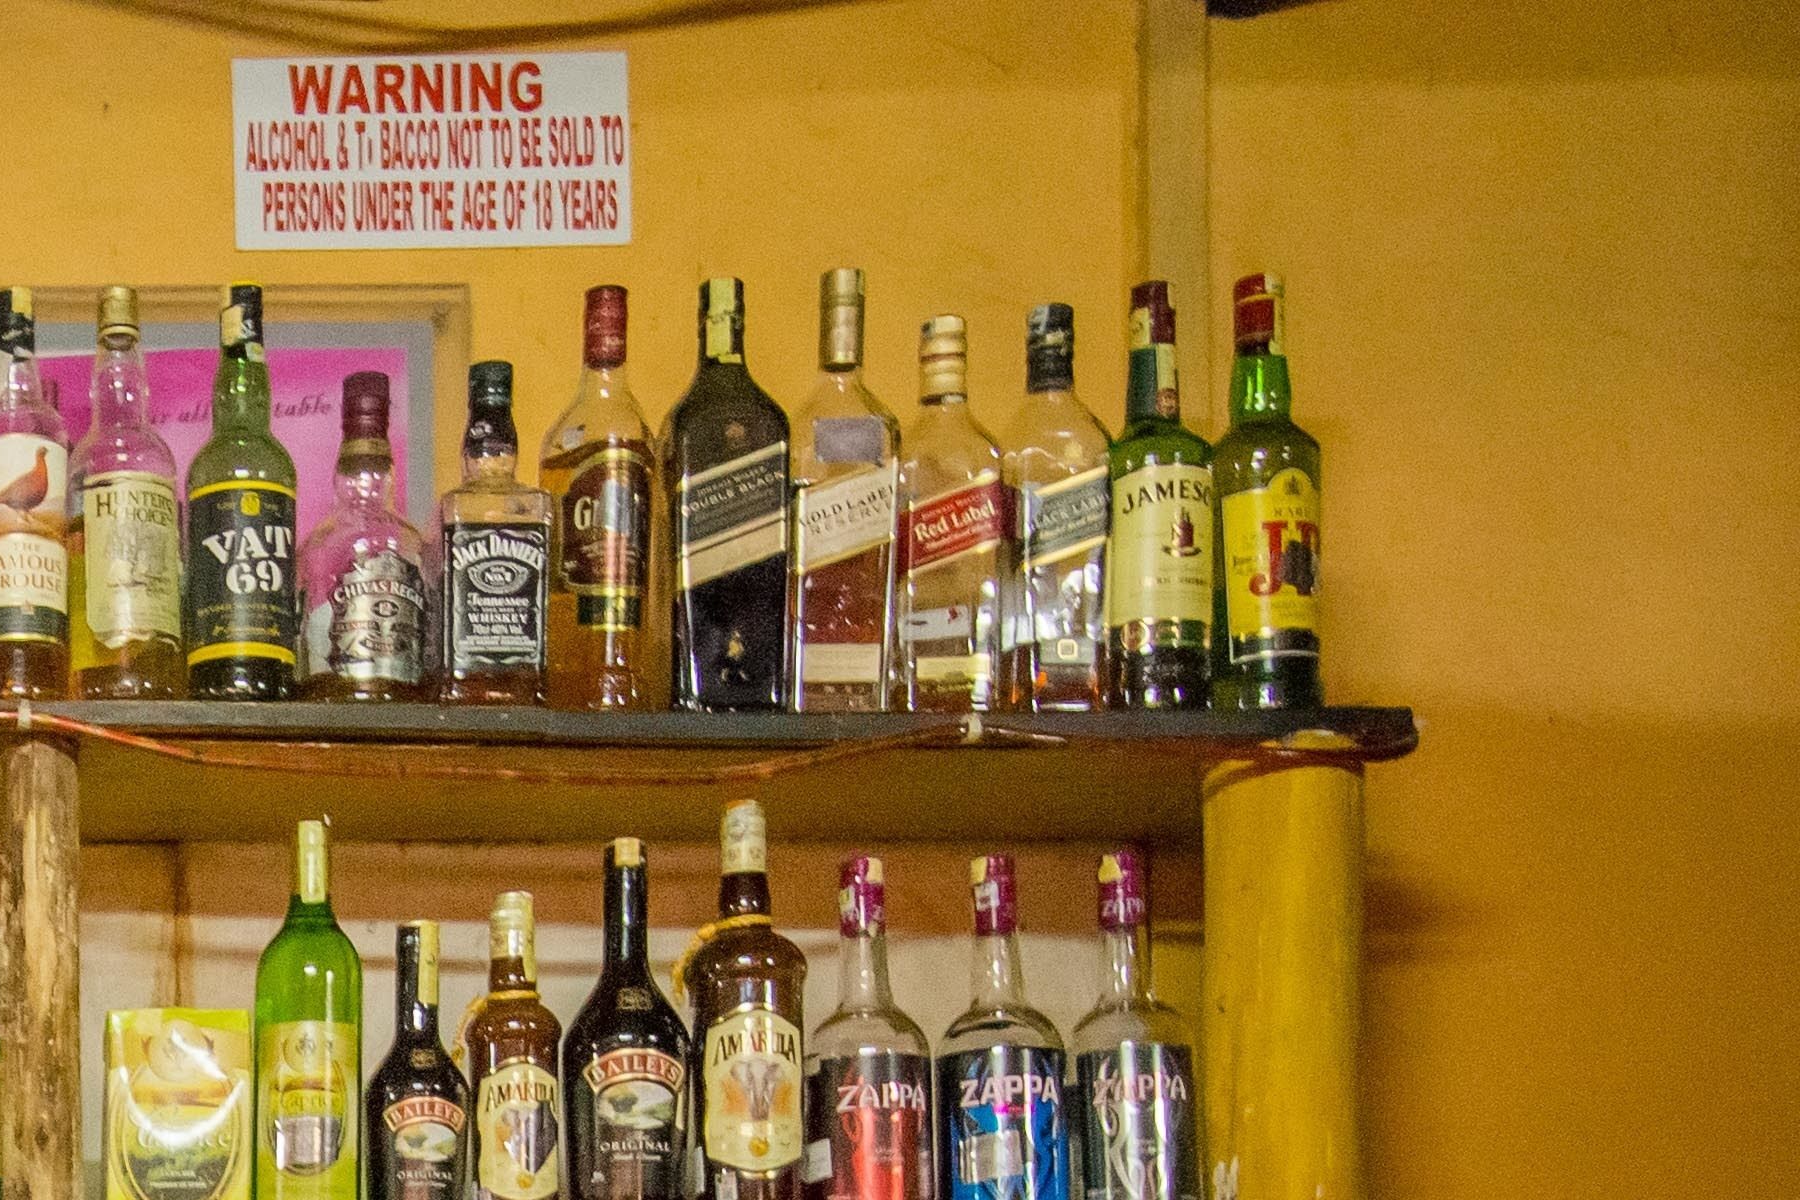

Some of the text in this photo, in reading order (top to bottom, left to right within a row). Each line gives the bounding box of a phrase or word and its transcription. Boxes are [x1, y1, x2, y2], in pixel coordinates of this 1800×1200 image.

[287, 60, 544, 115] WARNING
[245, 121, 331, 172] ALCOHOL
[336, 121, 349, 170] &
[447, 118, 484, 169] NOT
[490, 117, 513, 169] TO
[519, 116, 543, 168] BE
[548, 115, 595, 167] SOLD
[600, 114, 625, 166] TO
[262, 179, 619, 232] PERSONS UNDER THE AGE OF 18 YEARS
[912, 517, 950, 543] Red
[950, 500, 996, 530] Label
[201, 524, 293, 567] VAT
[451, 541, 492, 570] JACK
[225, 559, 284, 595] 69
[332, 579, 388, 604] CHIVAS
[714, 1025, 797, 1067] AMARULA
[590, 1053, 679, 1082] BAILEYS
[837, 1078, 927, 1114] ZAPPA
[958, 1072, 1060, 1108] ZAPPA
[1092, 1070, 1187, 1105] ZAPPA
[389, 1102, 462, 1126] BAILEYS
[600, 1140, 671, 1152] ORIGINAL
